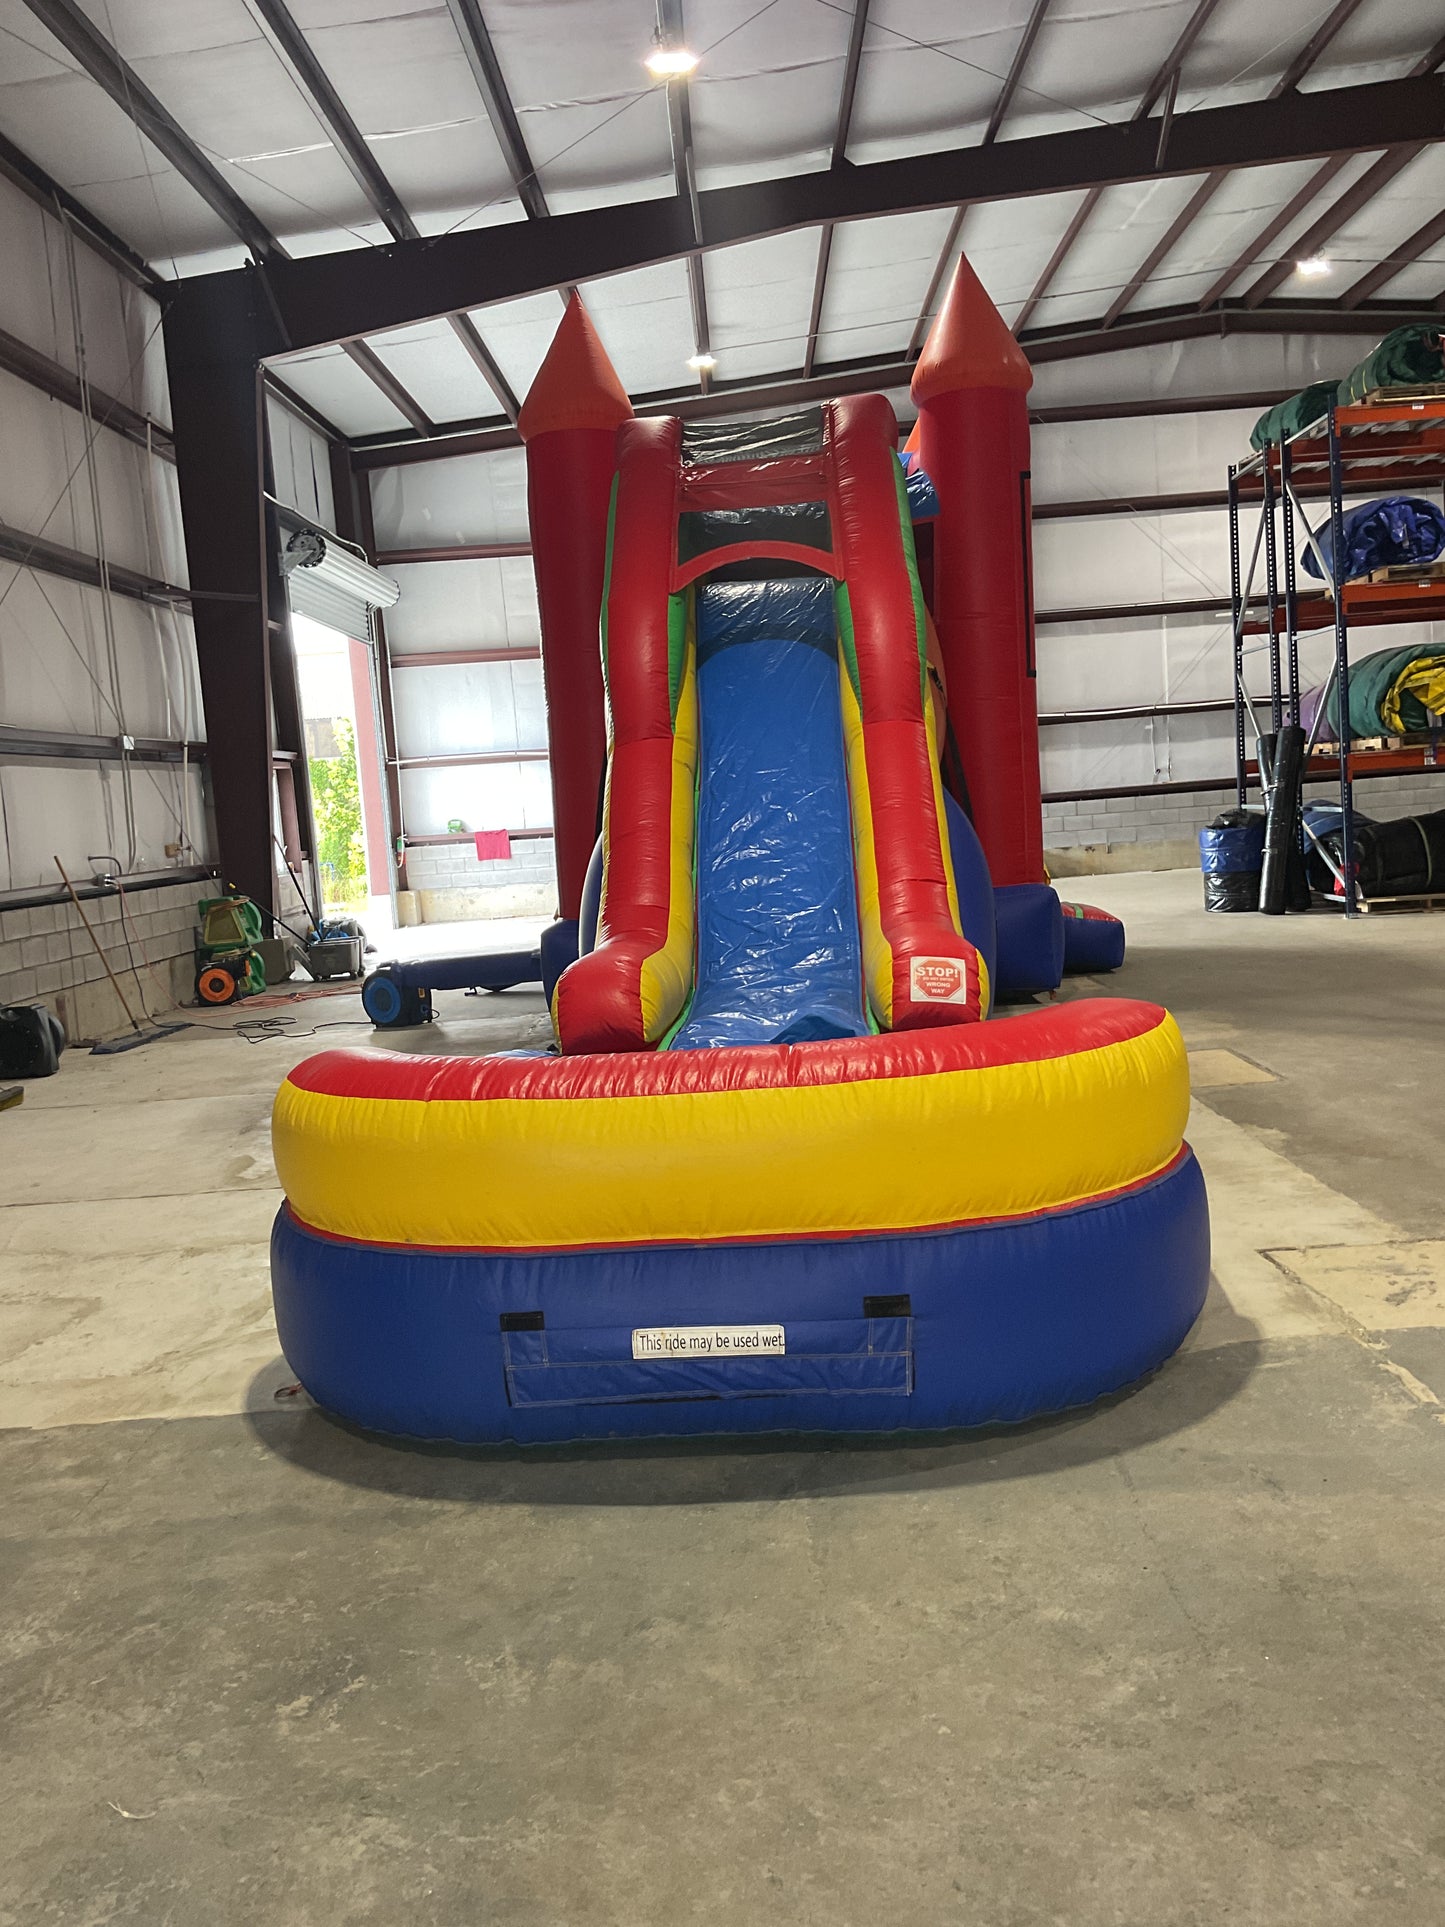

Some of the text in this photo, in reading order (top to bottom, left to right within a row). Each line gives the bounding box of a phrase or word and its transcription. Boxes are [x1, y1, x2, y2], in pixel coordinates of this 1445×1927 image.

[916, 967, 958, 978] STOP!
[639, 1334, 662, 1351] This
[664, 1333, 687, 1350] ride
[689, 1337, 713, 1353] may
[715, 1331, 730, 1348] be
[733, 1331, 759, 1348] used
